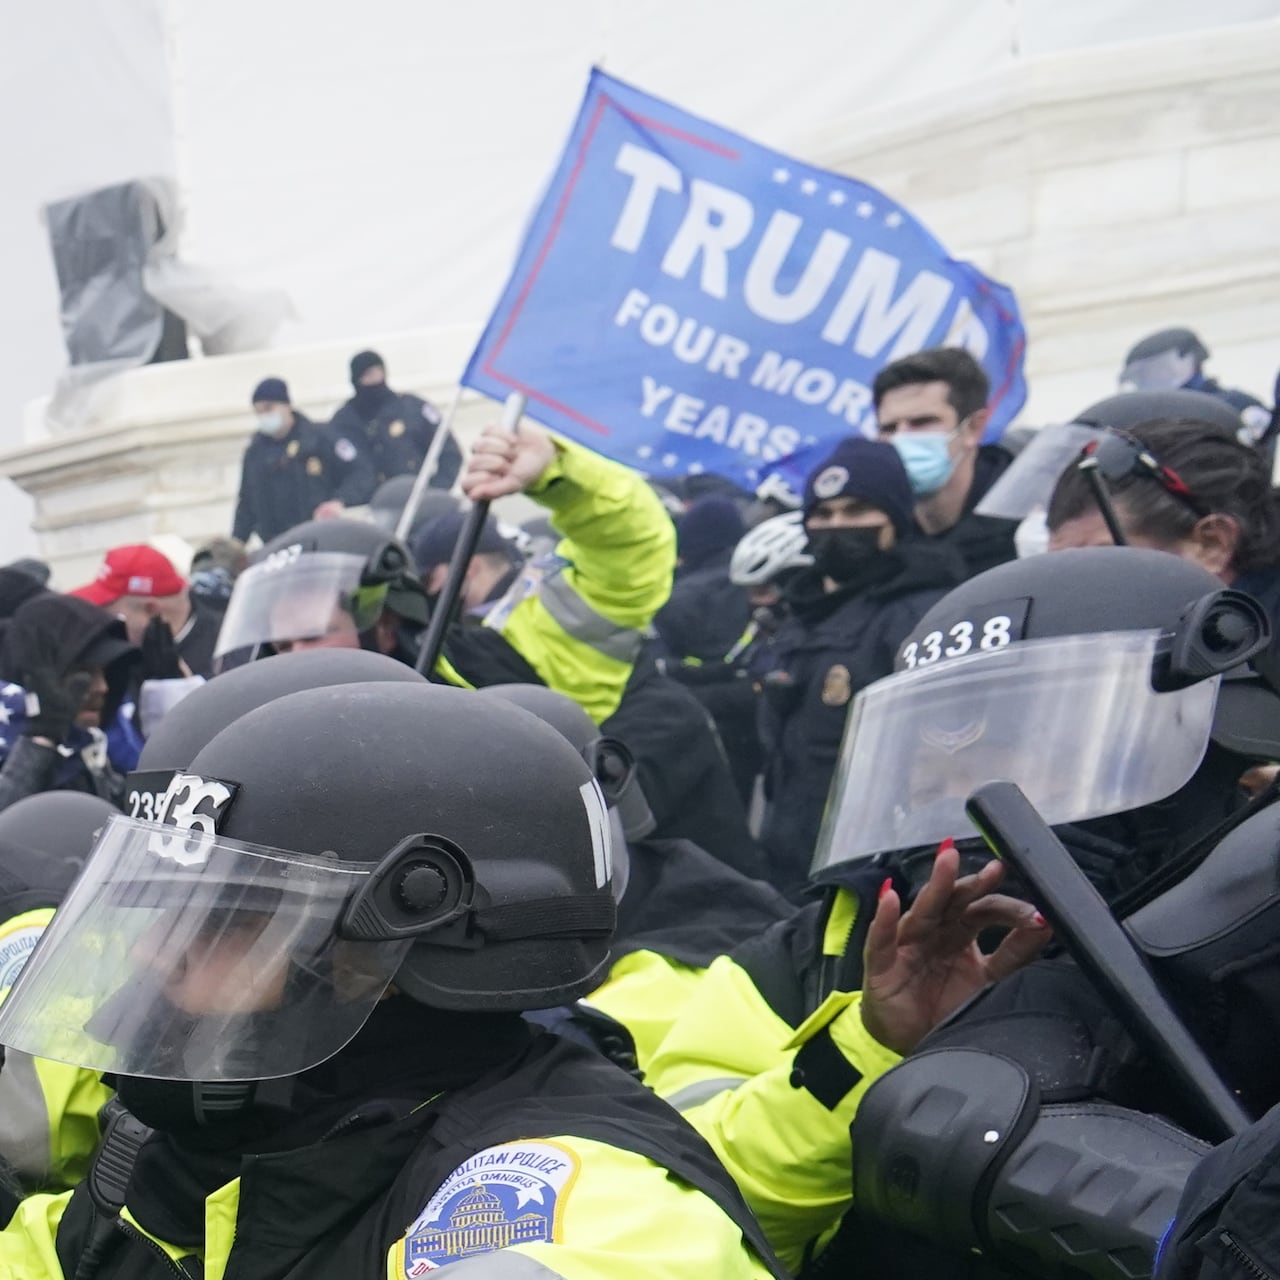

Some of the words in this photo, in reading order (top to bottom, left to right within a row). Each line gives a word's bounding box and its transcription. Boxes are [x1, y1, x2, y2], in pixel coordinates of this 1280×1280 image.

[615, 288, 750, 379] FOUR
[509, 1151, 567, 1175] POLICE
[479, 1173, 538, 1188] OMNIBUS
